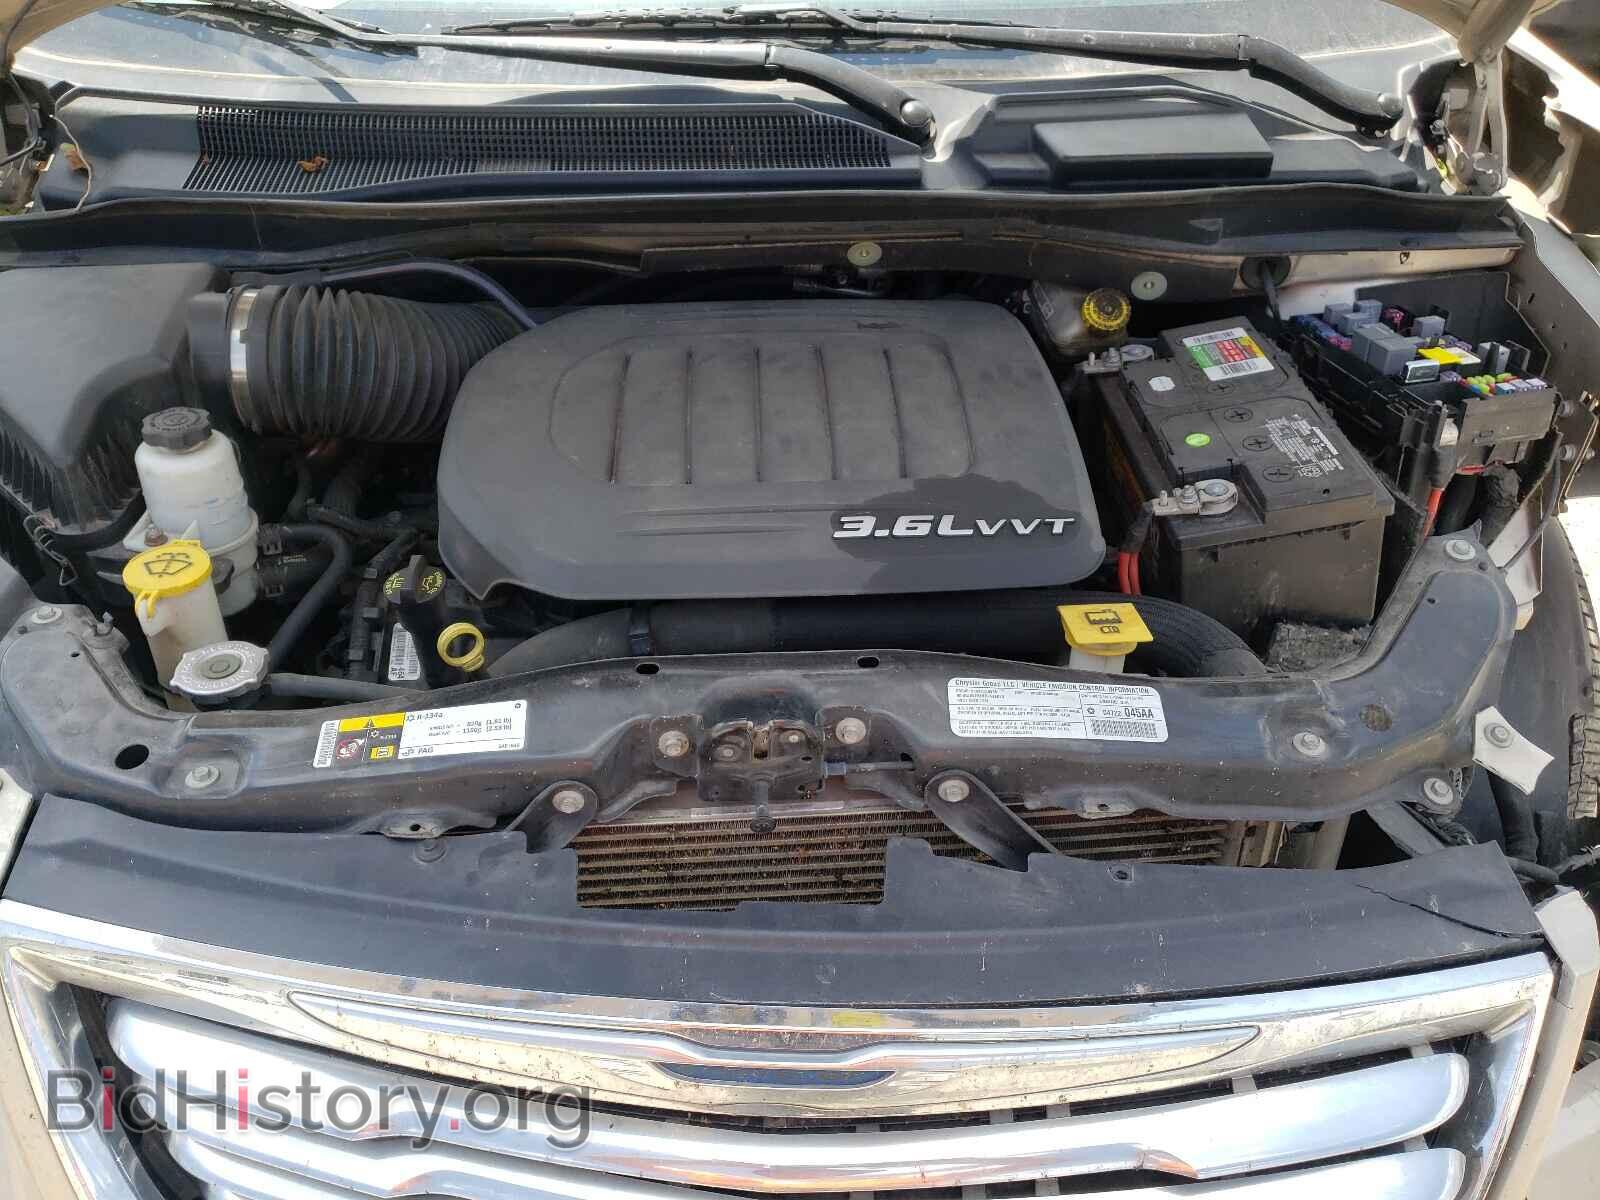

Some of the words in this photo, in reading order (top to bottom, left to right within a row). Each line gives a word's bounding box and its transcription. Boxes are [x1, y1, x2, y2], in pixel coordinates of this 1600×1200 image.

[955, 679, 980, 688] Chrysler
[982, 680, 1000, 688] Group
[1003, 681, 1015, 689] LLC
[1022, 681, 1046, 690] VEHICLE
[1048, 682, 1077, 691] EMISSION
[1078, 684, 1106, 692] CONTROL
[1108, 686, 1150, 694] INFORMATION
[1124, 707, 1154, 718] 045AA
[418, 747, 434, 756] PAG
